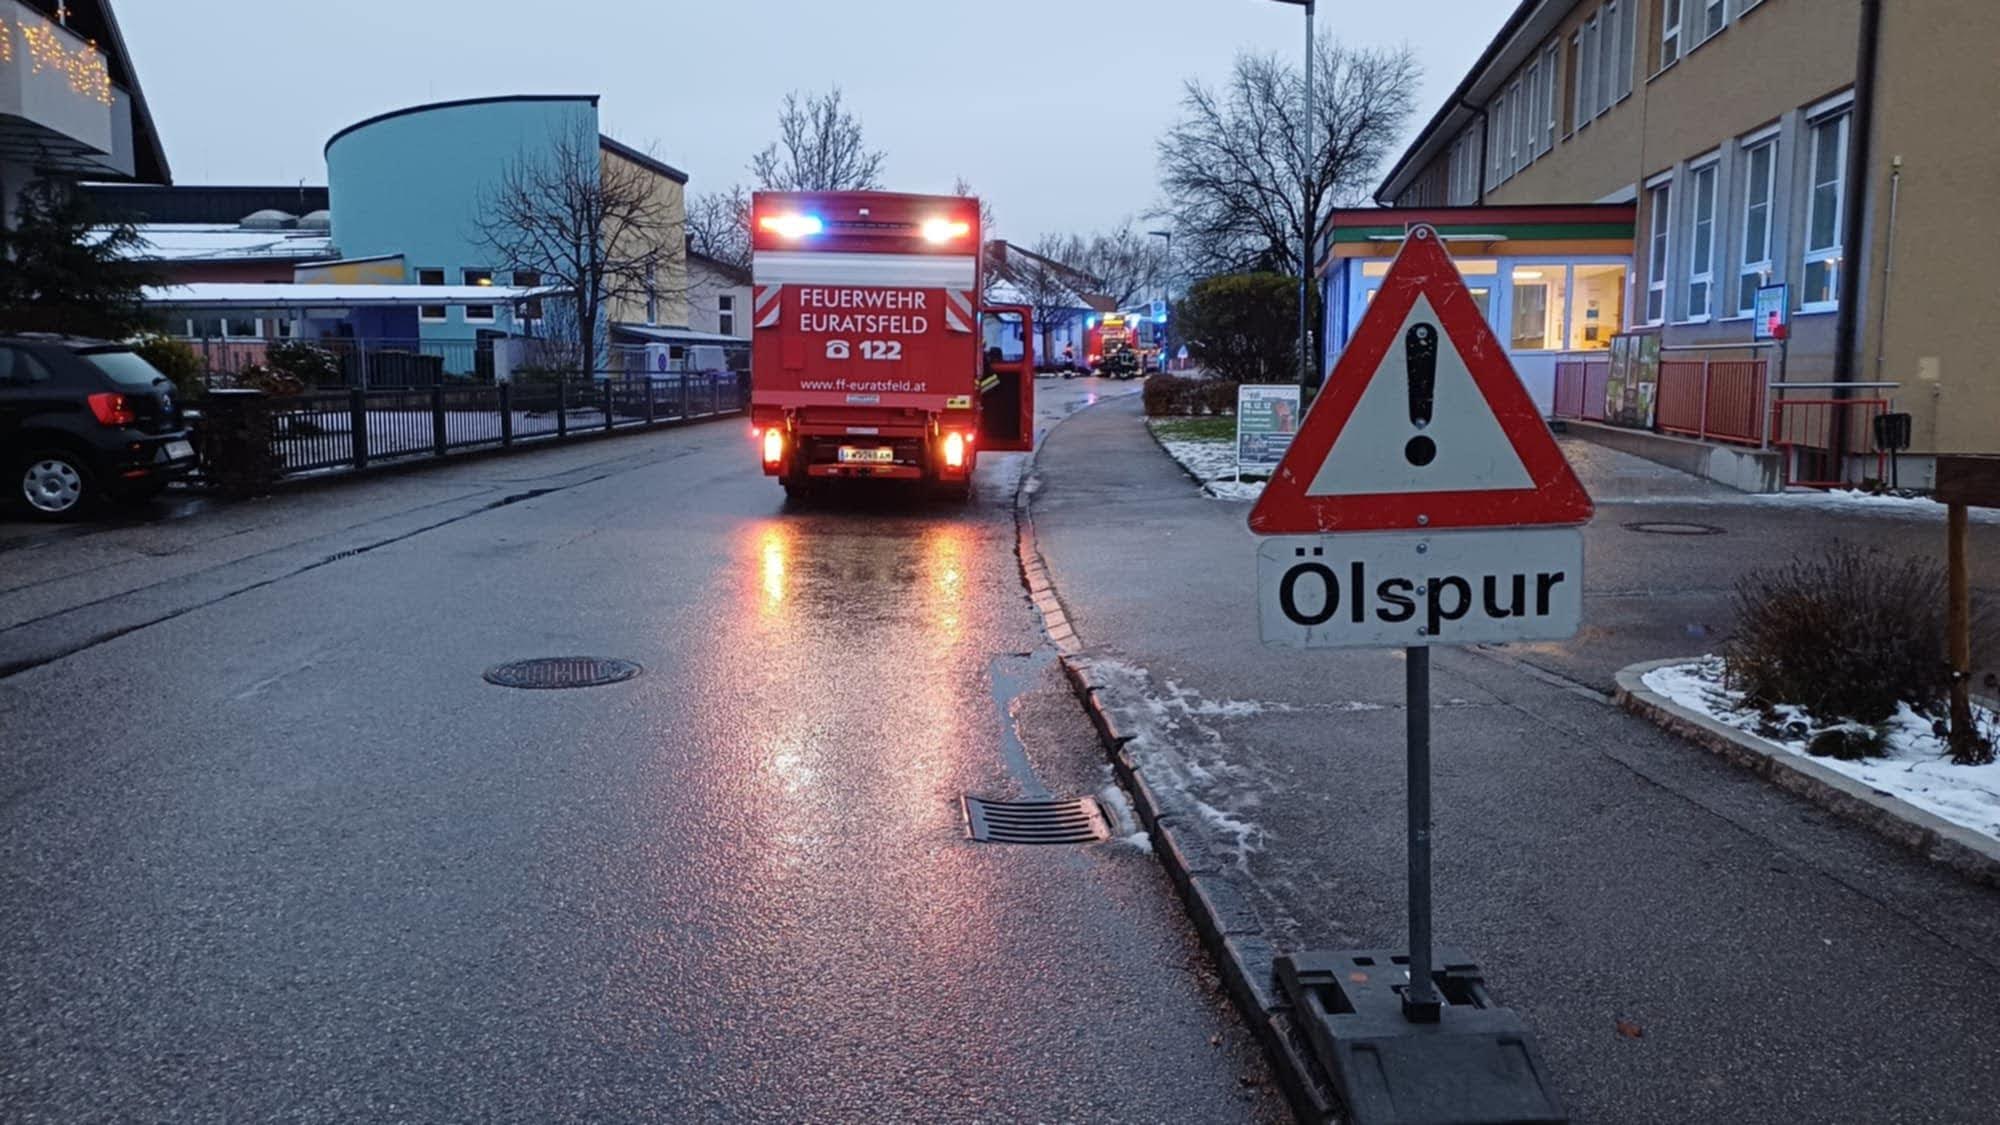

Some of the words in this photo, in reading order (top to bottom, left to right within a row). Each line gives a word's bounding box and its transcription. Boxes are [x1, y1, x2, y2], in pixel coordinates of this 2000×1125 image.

[800, 288, 927, 309] FEUERWEHR
[800, 313, 928, 334] EURATSFELD
[859, 340, 902, 360] 122
[800, 379, 927, 392] www.ff-euratsfeld.at
[1279, 547, 1566, 636] Ölspur
